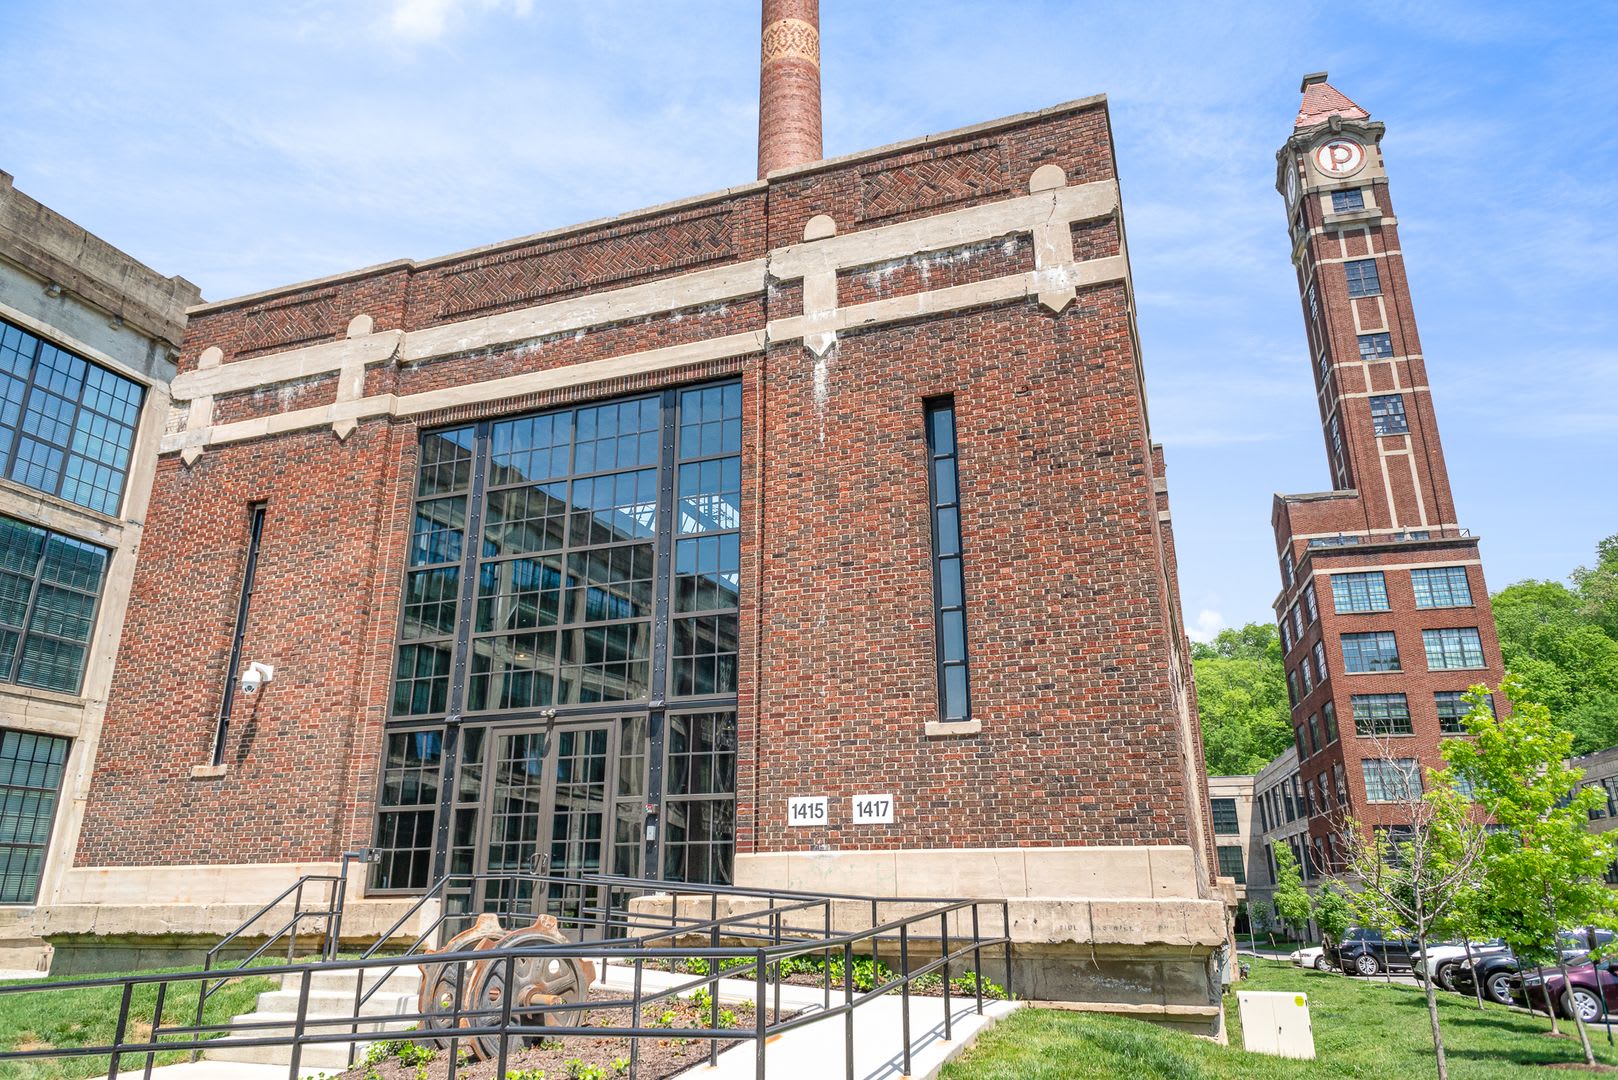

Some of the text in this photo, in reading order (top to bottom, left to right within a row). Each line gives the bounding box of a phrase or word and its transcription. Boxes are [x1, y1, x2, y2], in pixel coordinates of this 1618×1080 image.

[1328, 144, 1352, 170] P
[791, 803, 824, 819] 1415
[857, 801, 889, 817] 1417
